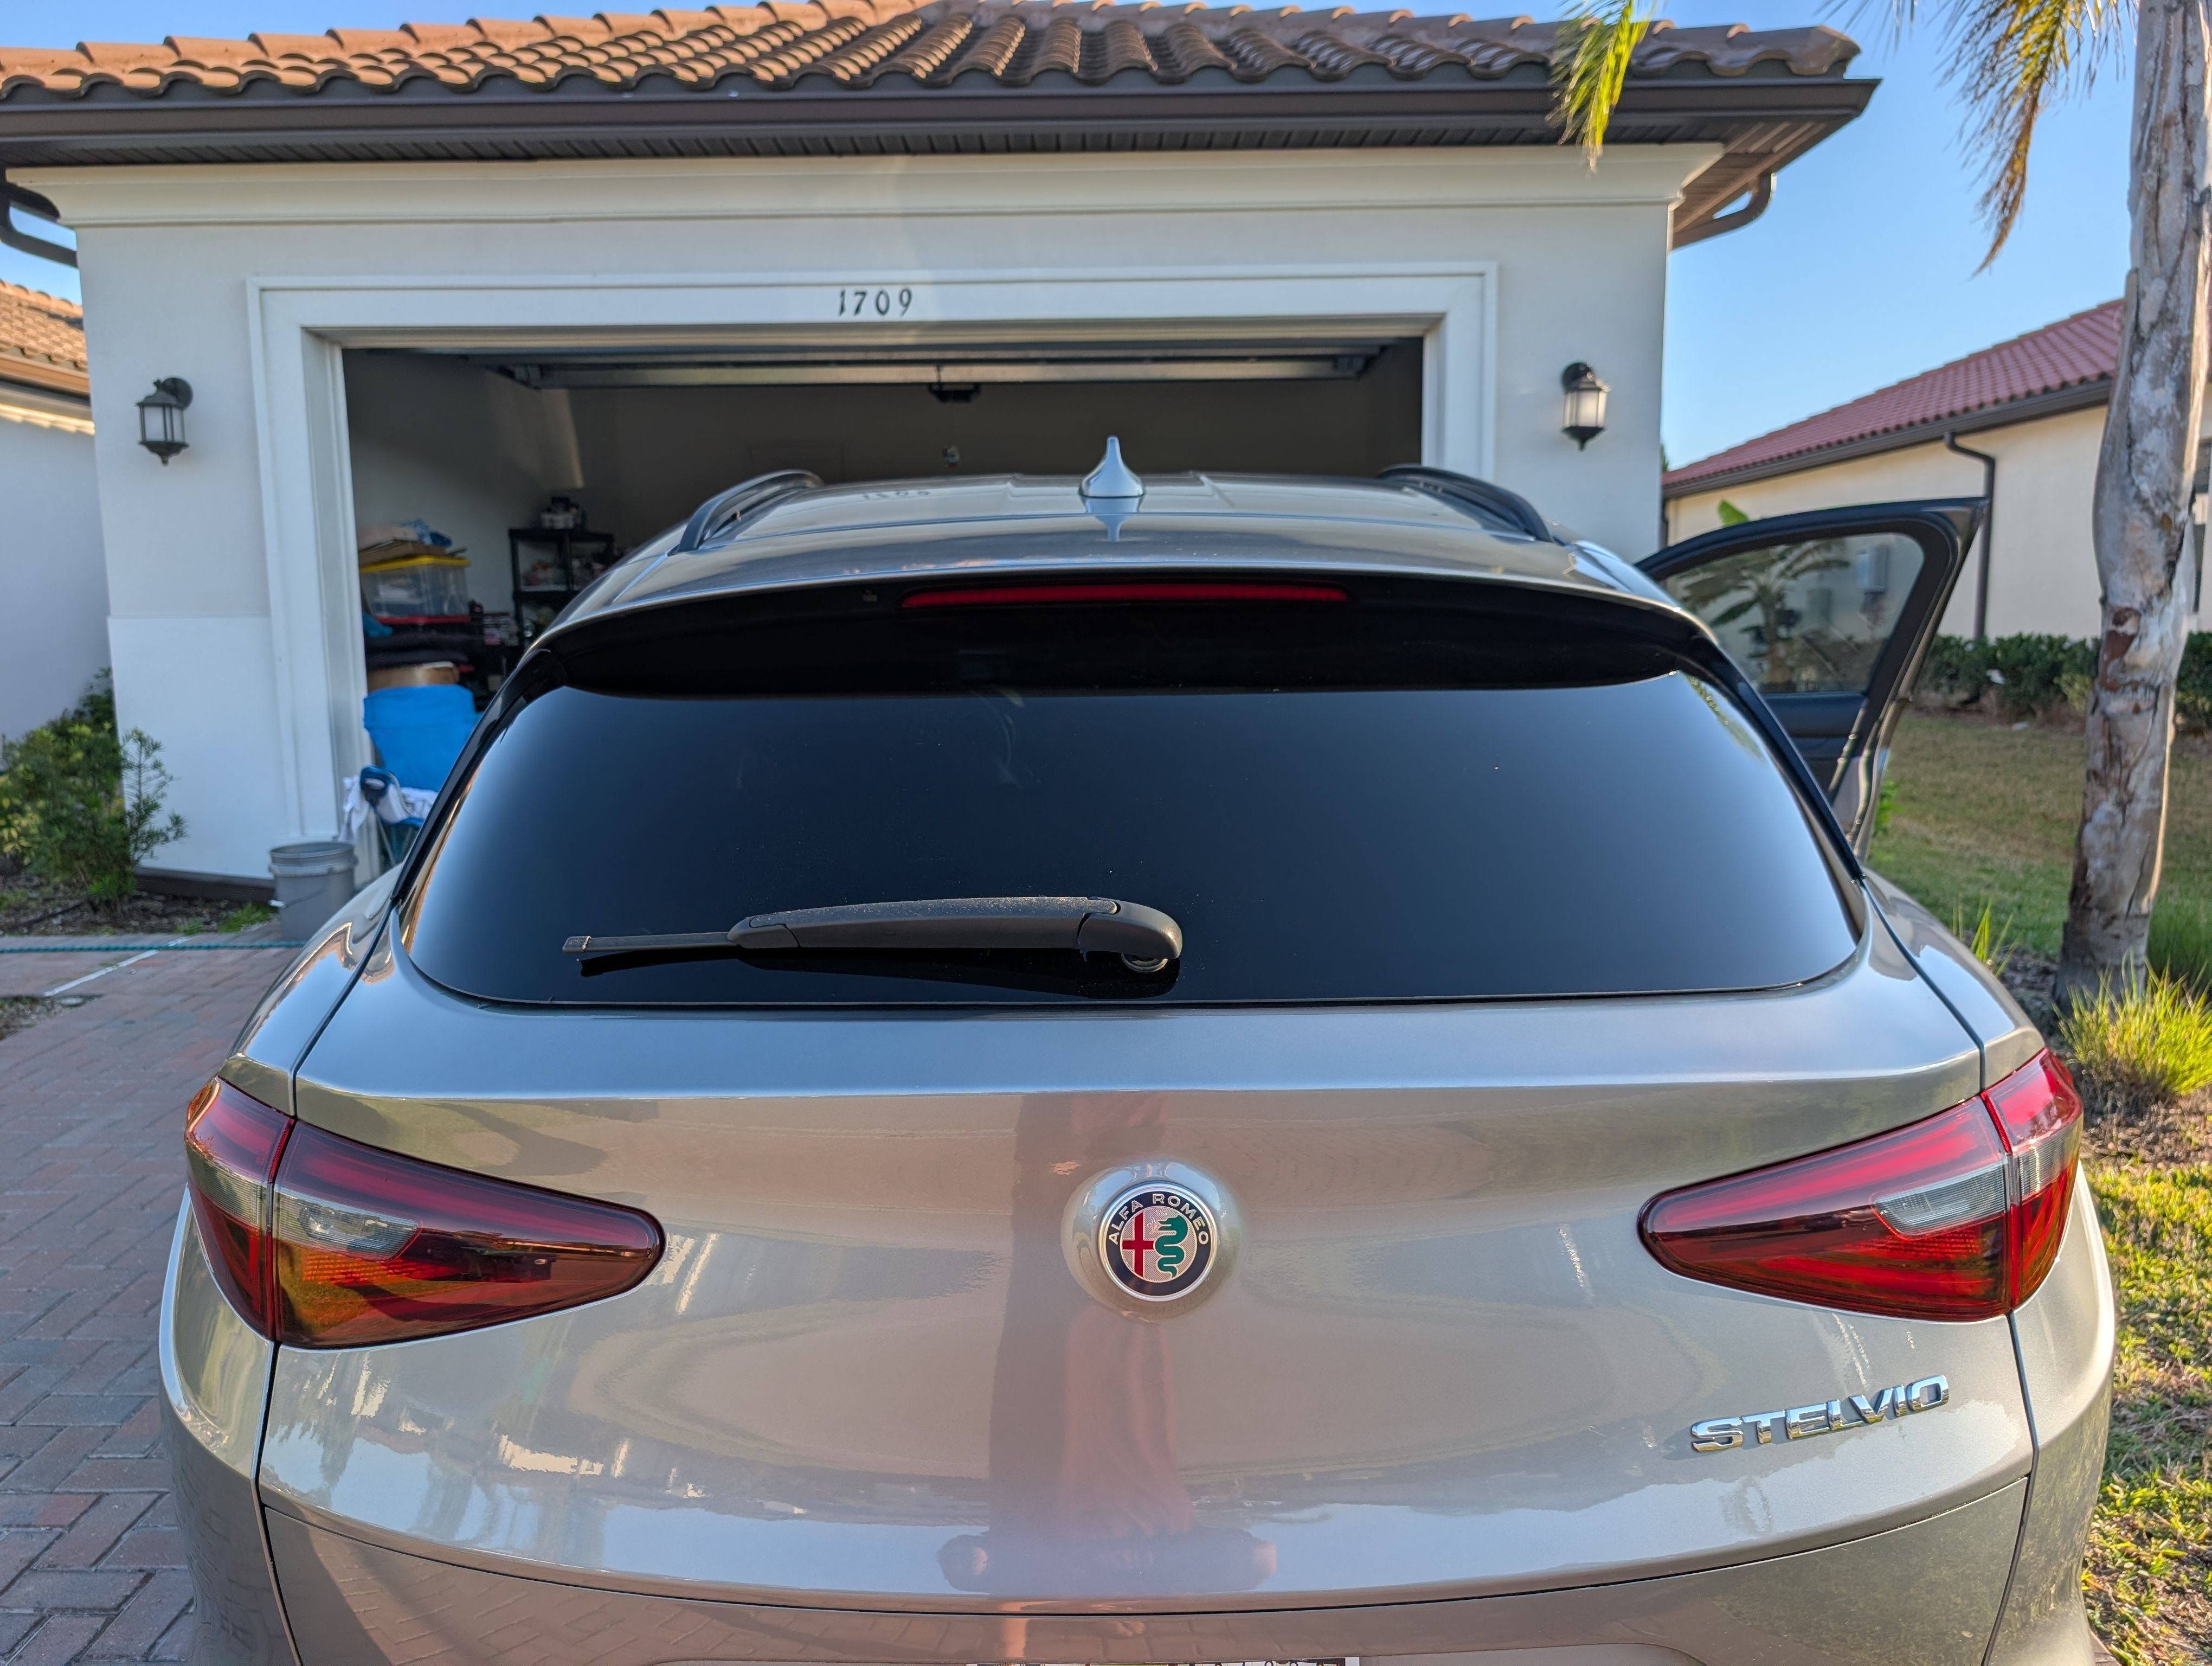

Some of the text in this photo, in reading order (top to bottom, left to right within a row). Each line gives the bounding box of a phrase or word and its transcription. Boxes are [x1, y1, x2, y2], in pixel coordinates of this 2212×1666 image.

[839, 288, 912, 316] 1709
[1108, 1193, 1209, 1245] ALFA ROMEO
[1691, 1375, 1949, 1452] STELVIO
